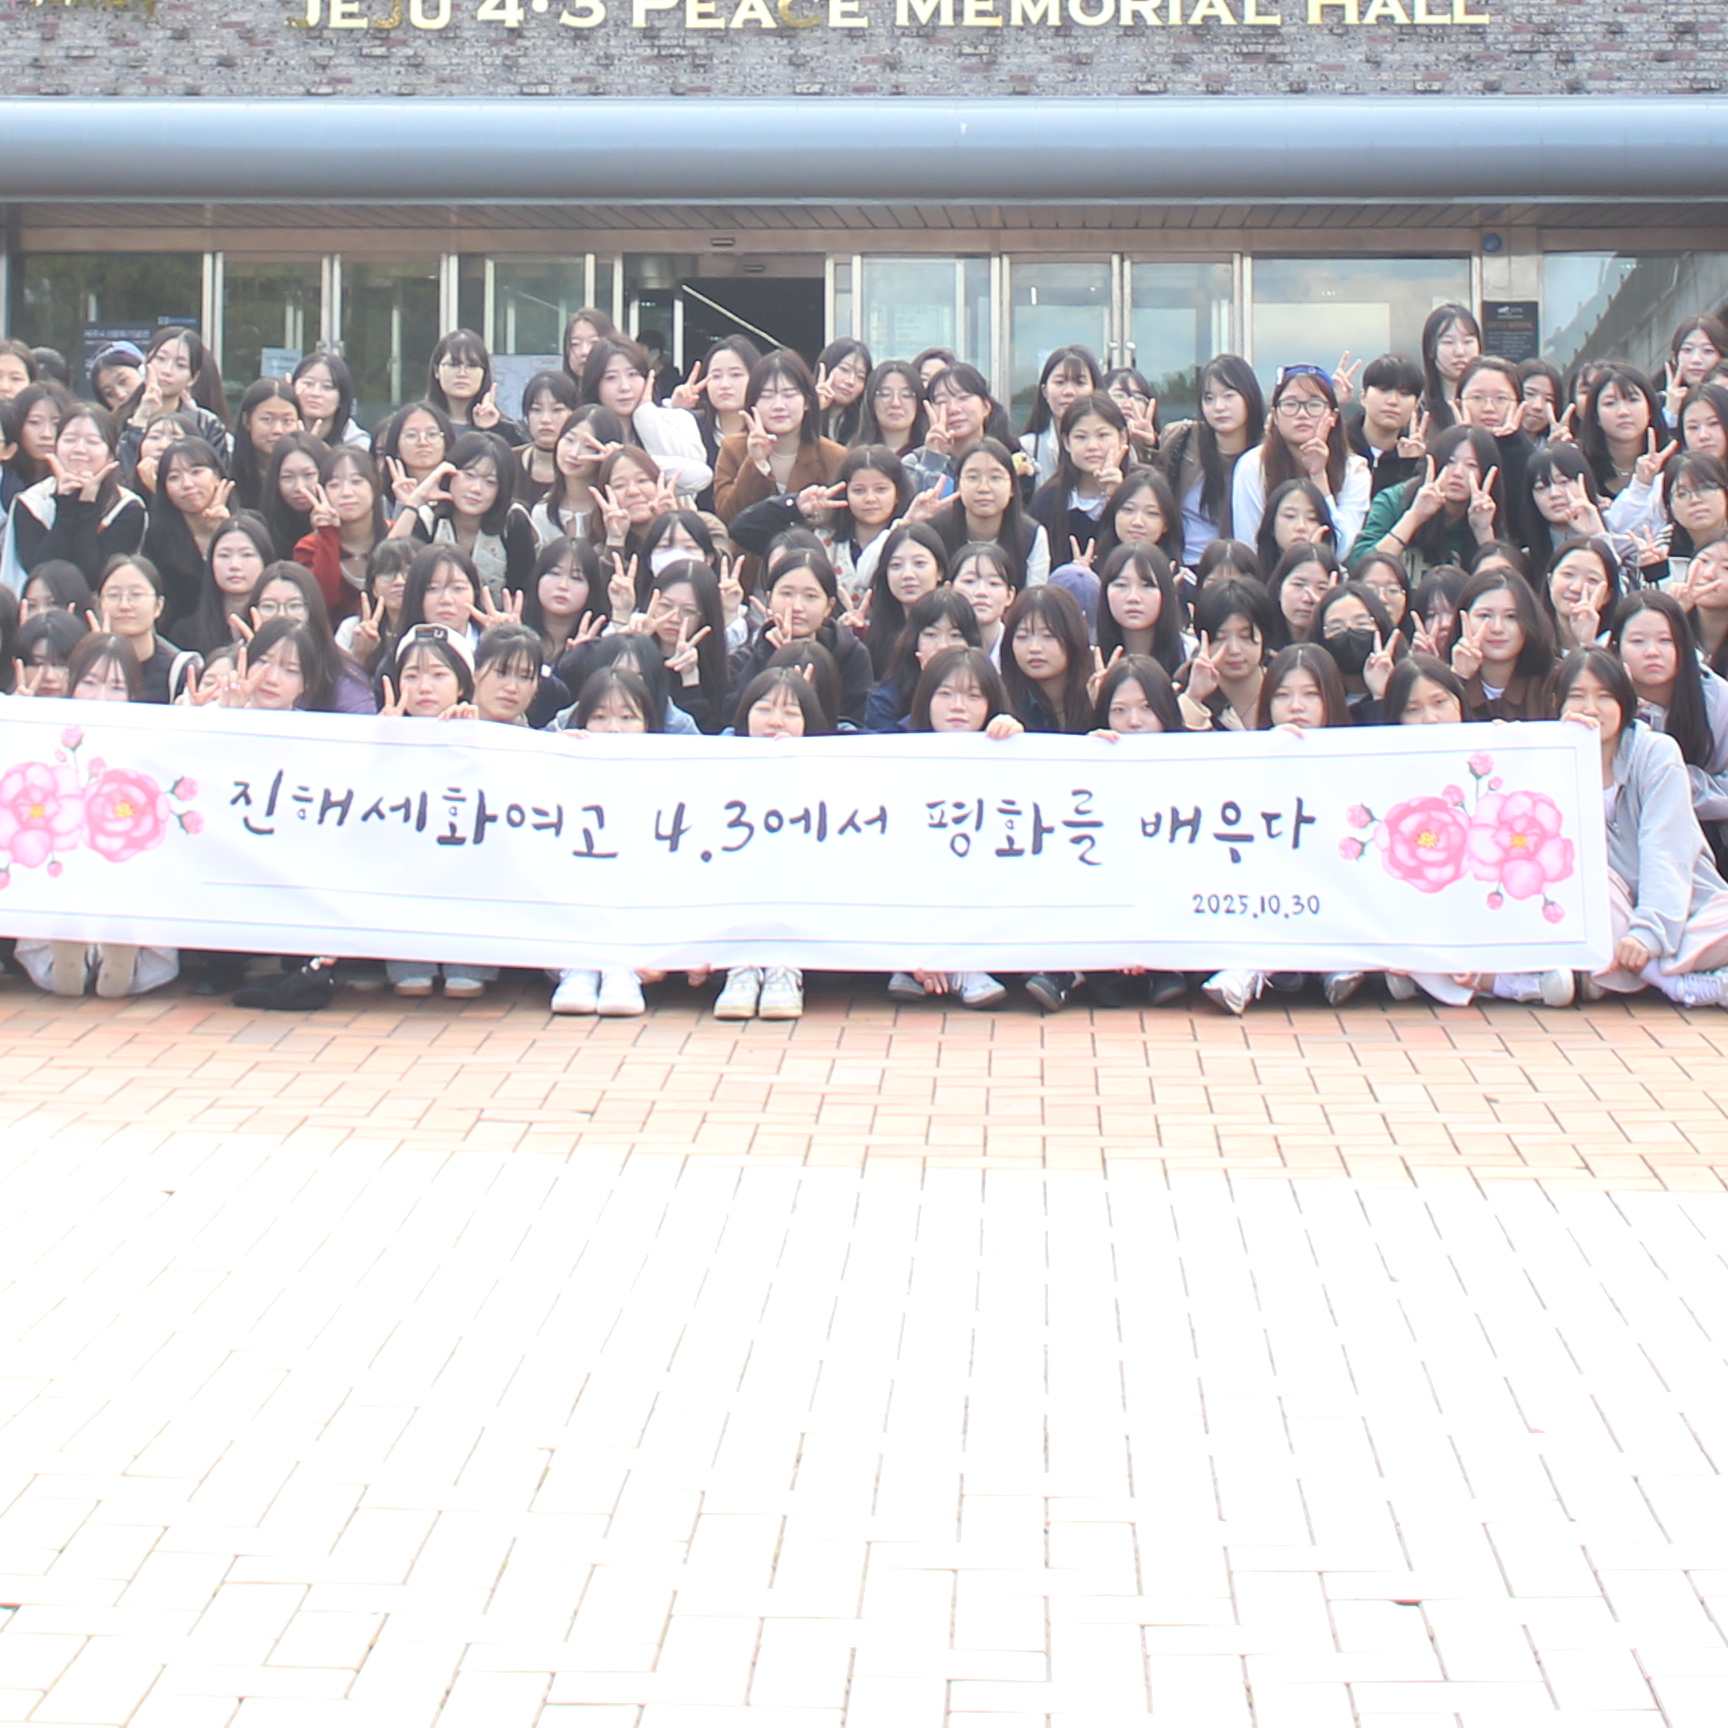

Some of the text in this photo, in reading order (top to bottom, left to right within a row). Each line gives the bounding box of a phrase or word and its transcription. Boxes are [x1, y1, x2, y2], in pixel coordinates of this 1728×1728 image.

[229, 769, 1317, 867] 진해세화여고 4.3에서 평화를 배우다
[1191, 893, 1321, 921] 2025.10.30
